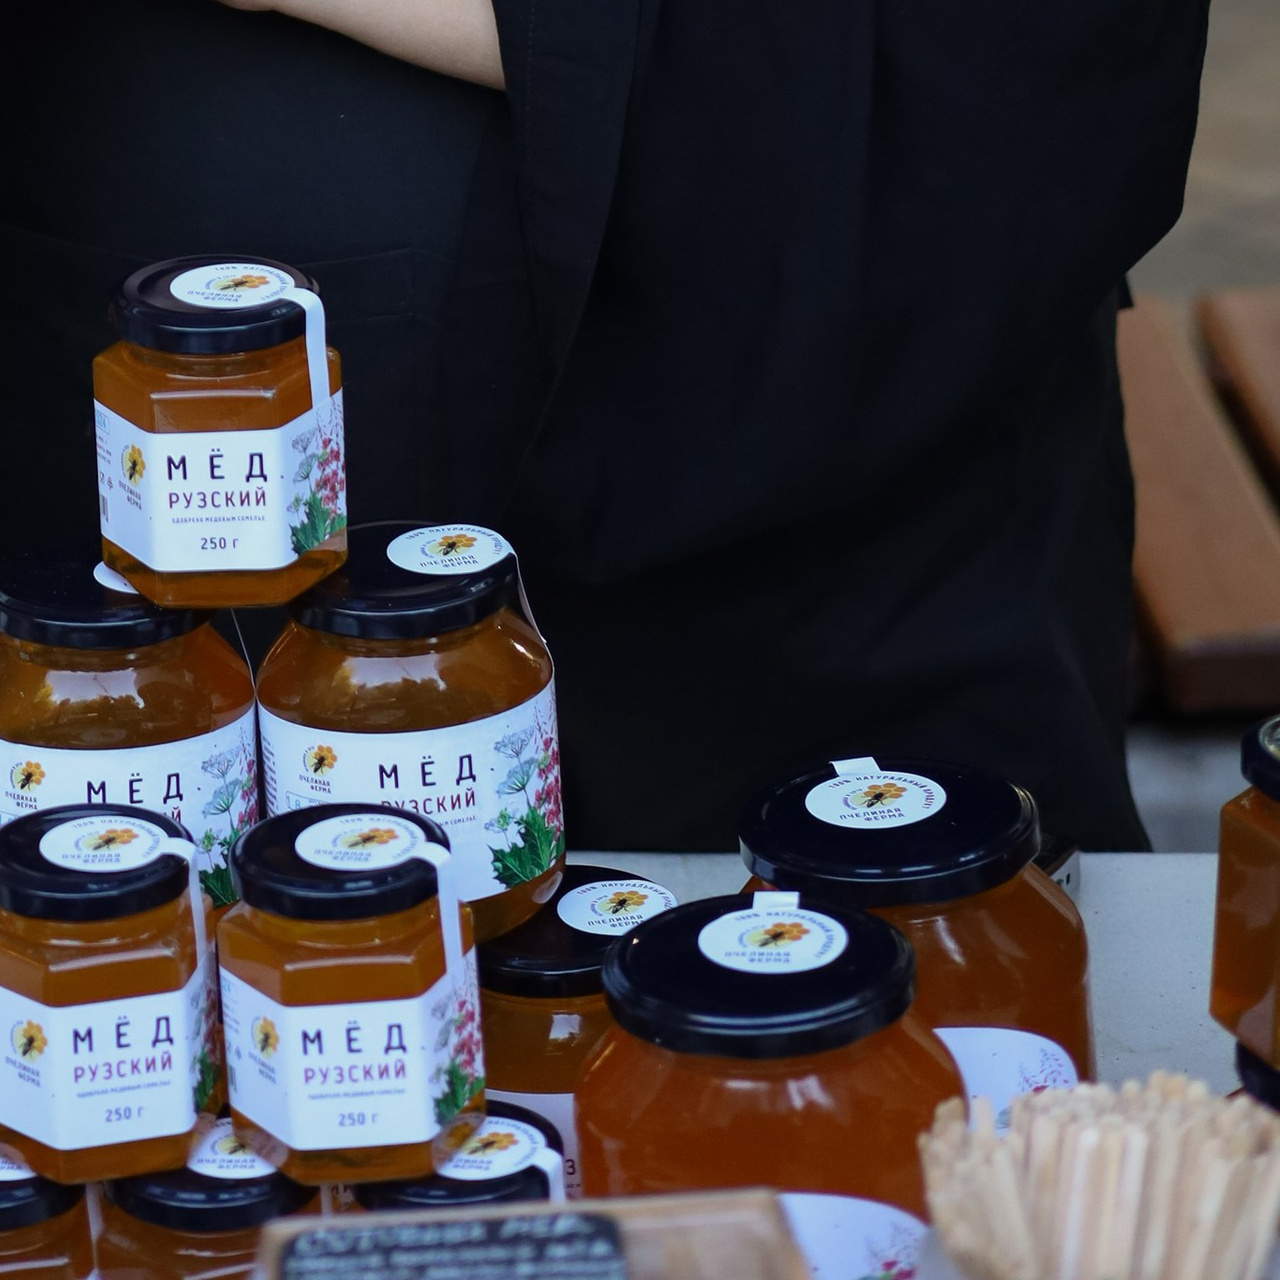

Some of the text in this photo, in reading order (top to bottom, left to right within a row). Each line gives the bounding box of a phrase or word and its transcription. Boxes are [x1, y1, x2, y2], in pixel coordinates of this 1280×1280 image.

[167, 448, 268, 482] МЁД
[169, 486, 267, 509] РУЗСКИЙ
[201, 537, 227, 550] 250
[420, 554, 475, 567] ПЧЕЛИНАЯ
[379, 755, 477, 789] МЁД
[86, 773, 184, 804] МЁД
[4, 791, 38, 803] ПЧЕЛИНАЯ
[16, 800, 38, 811] ФЕРМА
[839, 807, 901, 820] ПЧЕЛИНАЯ
[864, 813, 905, 821] ФЕРМА
[588, 914, 643, 926] ПЧЕЛИНАЯ
[72, 1015, 174, 1054] МЁД
[301, 1020, 407, 1055] МЁД
[74, 1050, 173, 1083] РУЗСКИЙ
[304, 1059, 407, 1084] РУЗСКИЙ
[105, 1106, 132, 1122] 250
[338, 1113, 366, 1127] 250
